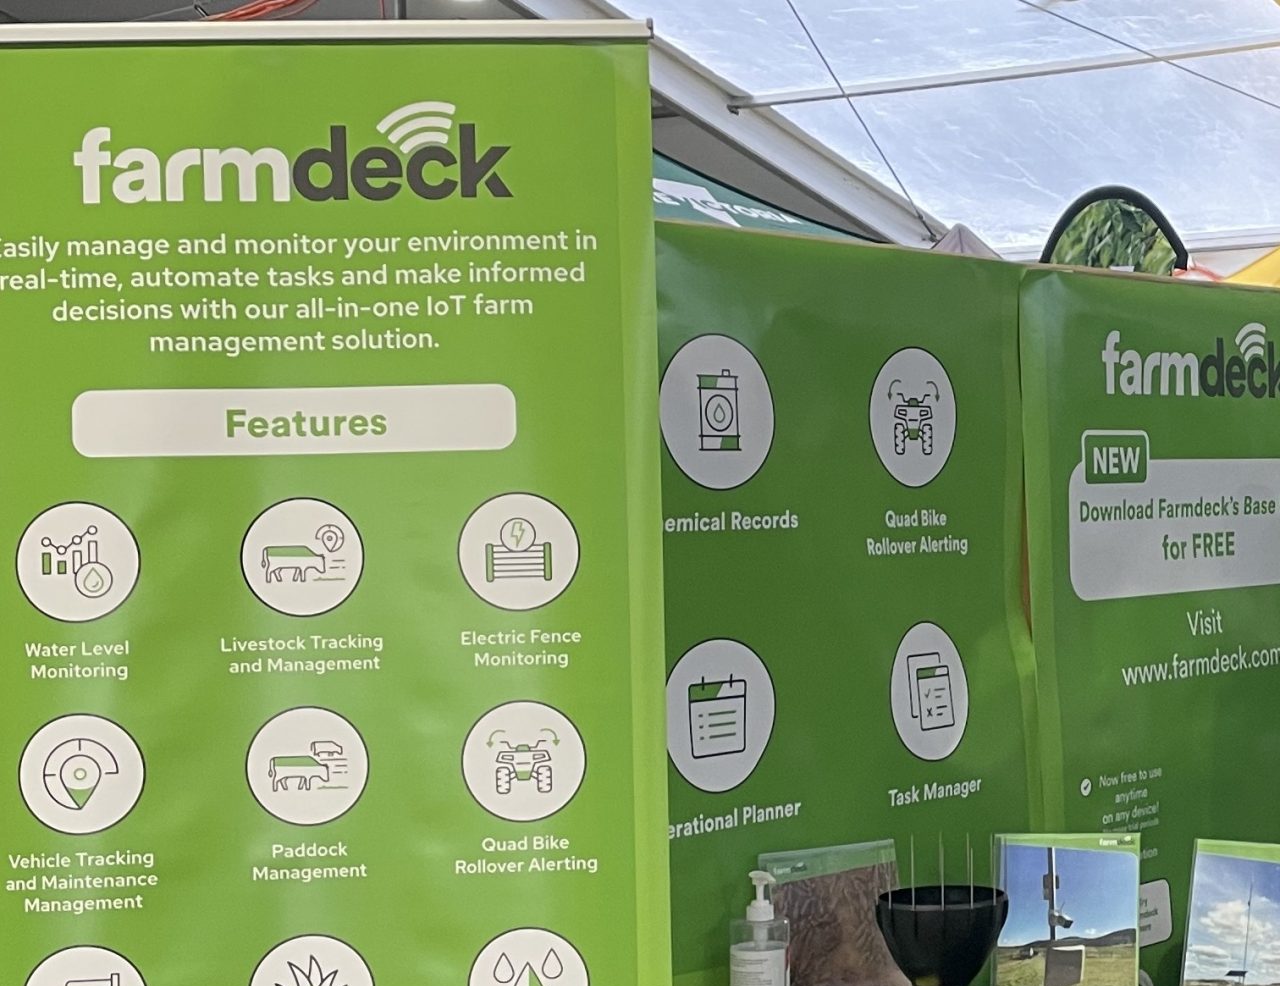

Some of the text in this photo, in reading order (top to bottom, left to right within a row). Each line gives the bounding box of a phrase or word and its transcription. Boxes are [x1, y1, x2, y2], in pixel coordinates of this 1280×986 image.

[73, 122, 514, 204] farmdeck
[68, 239, 169, 260] manage
[178, 234, 226, 254] and
[235, 233, 337, 254] monitor
[344, 238, 400, 258] your
[408, 230, 568, 251] environment
[576, 230, 596, 249] in
[0, 261, 584, 291] real-time, automate tasks and make informed
[53, 293, 532, 321] decisions with our all-in-one IoT farm
[151, 328, 439, 357] management solution.
[227, 410, 386, 437] Features
[1094, 447, 1139, 474] NEW
[1080, 499, 1153, 522] Download
[1159, 496, 1239, 518] Farmdeck's
[1244, 496, 1275, 514] Base
[664, 510, 798, 532] emical Records
[886, 510, 946, 528] Quad Bike
[867, 535, 967, 555] Rollover Alerting
[1162, 532, 1234, 560] for FREE
[1187, 609, 1222, 635] Visit
[221, 634, 383, 651] Livestock Tracking
[462, 630, 581, 645] Electric Fence
[26, 641, 128, 657] Water Level
[230, 657, 379, 674] and Management
[475, 651, 568, 667] Monitoring
[32, 663, 127, 680] Monitoring
[1100, 776, 1118, 787] Now
[1121, 772, 1137, 783] free
[1139, 770, 1147, 779] to
[888, 779, 981, 806] Task Manager
[669, 803, 801, 840] erational Planner
[1103, 814, 1113, 824] on
[272, 842, 347, 858] Paddock
[482, 836, 569, 851] Quad Bike
[9, 850, 153, 868] Vehicle Tracking
[456, 856, 597, 873] Rollover Alerting
[253, 864, 366, 882] Management
[7, 875, 157, 890] and Maintenance
[25, 895, 142, 914] Management
